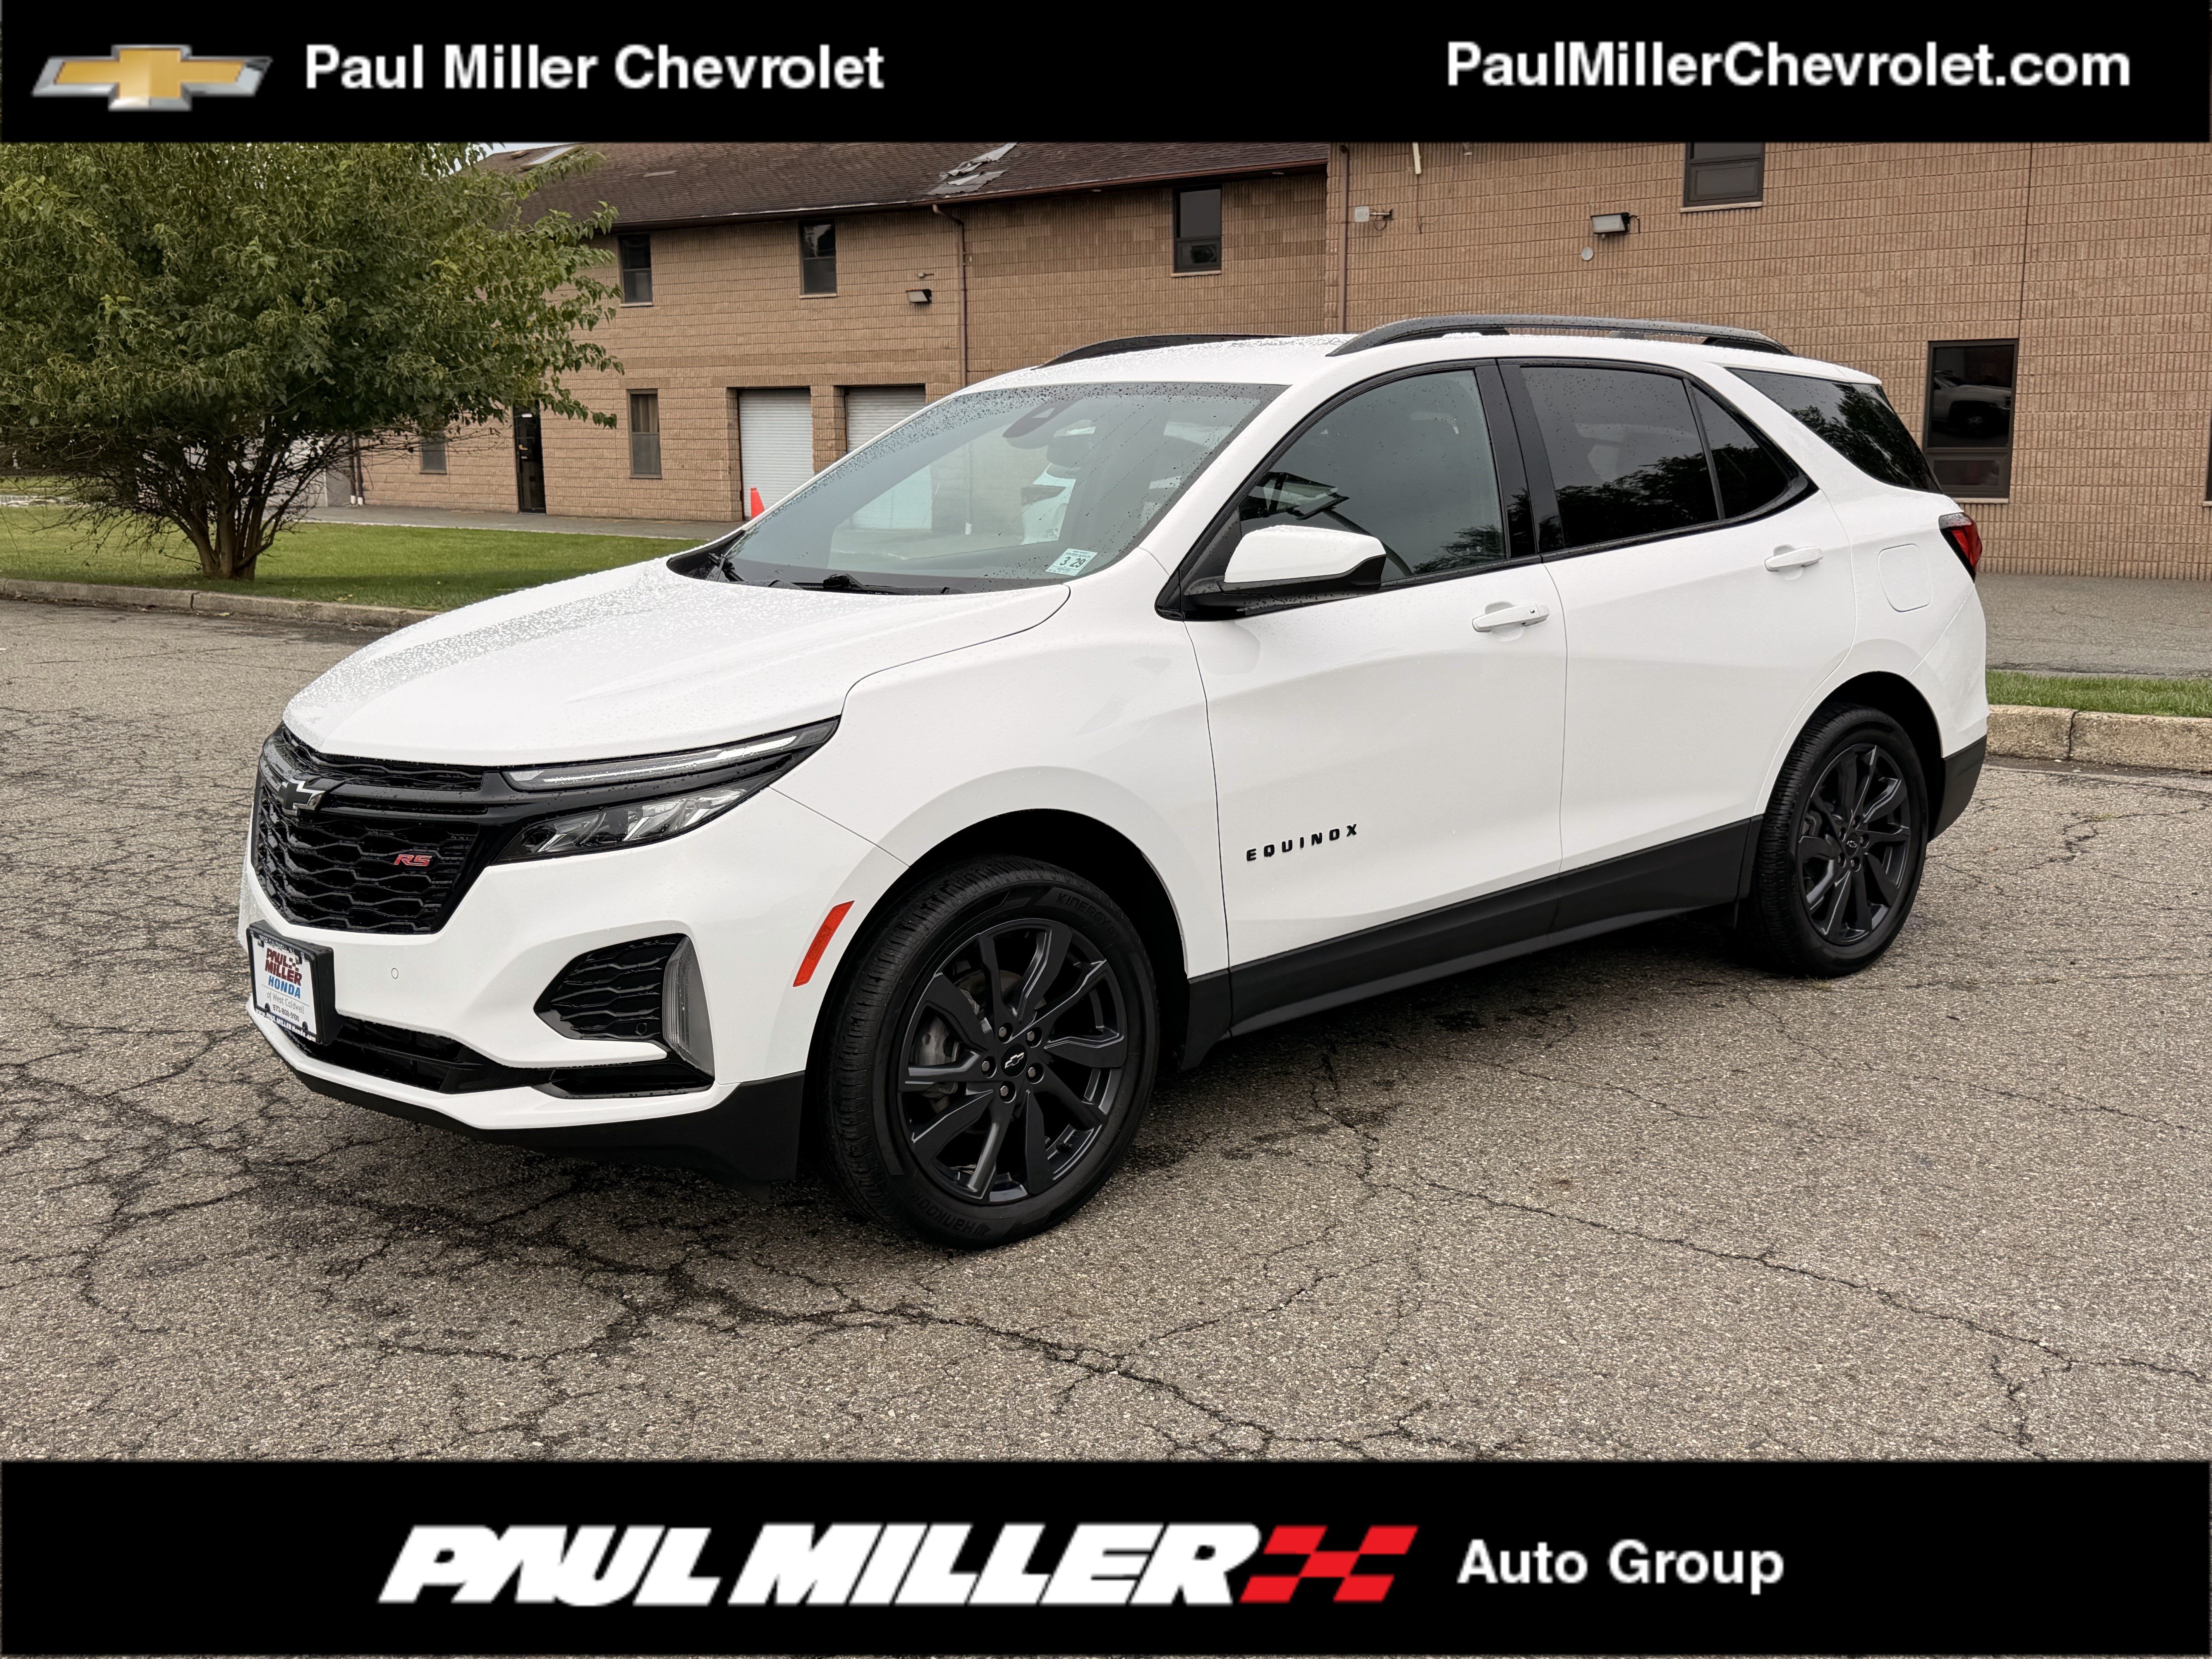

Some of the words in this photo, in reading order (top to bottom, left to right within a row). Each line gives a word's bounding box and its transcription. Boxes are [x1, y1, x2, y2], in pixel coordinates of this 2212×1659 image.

[1060, 556, 1071, 566] 3
[1069, 558, 1086, 568] 29
[1246, 823, 1357, 862] EQUINOX
[393, 854, 433, 866] RS
[266, 948, 290, 968] PAUL
[265, 959, 302, 986] MILLER
[268, 975, 301, 999] HONDA
